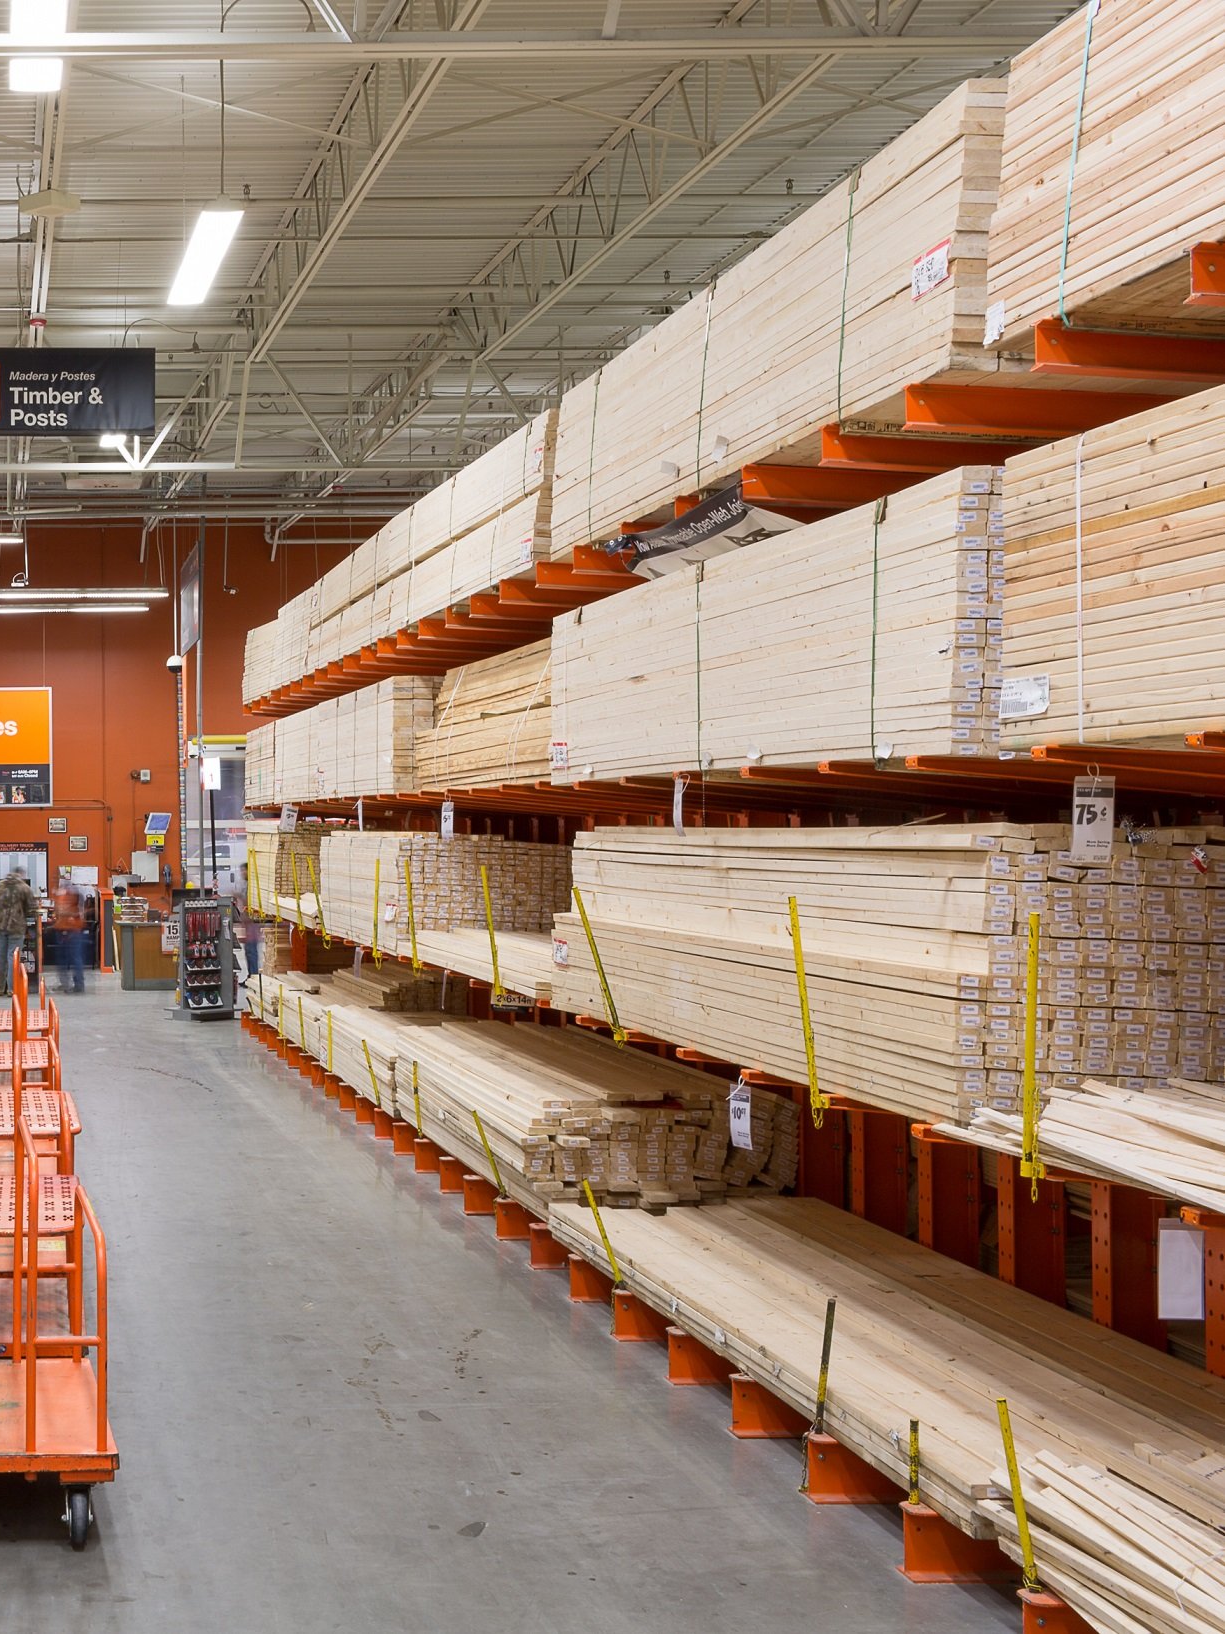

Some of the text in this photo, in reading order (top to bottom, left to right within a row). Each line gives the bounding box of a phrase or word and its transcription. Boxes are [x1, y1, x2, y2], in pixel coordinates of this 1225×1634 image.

[9, 371, 96, 383] Madera y Postes
[9, 387, 104, 405] Timber &
[10, 409, 68, 426] Posts
[695, 508, 732, 534] Open-Web
